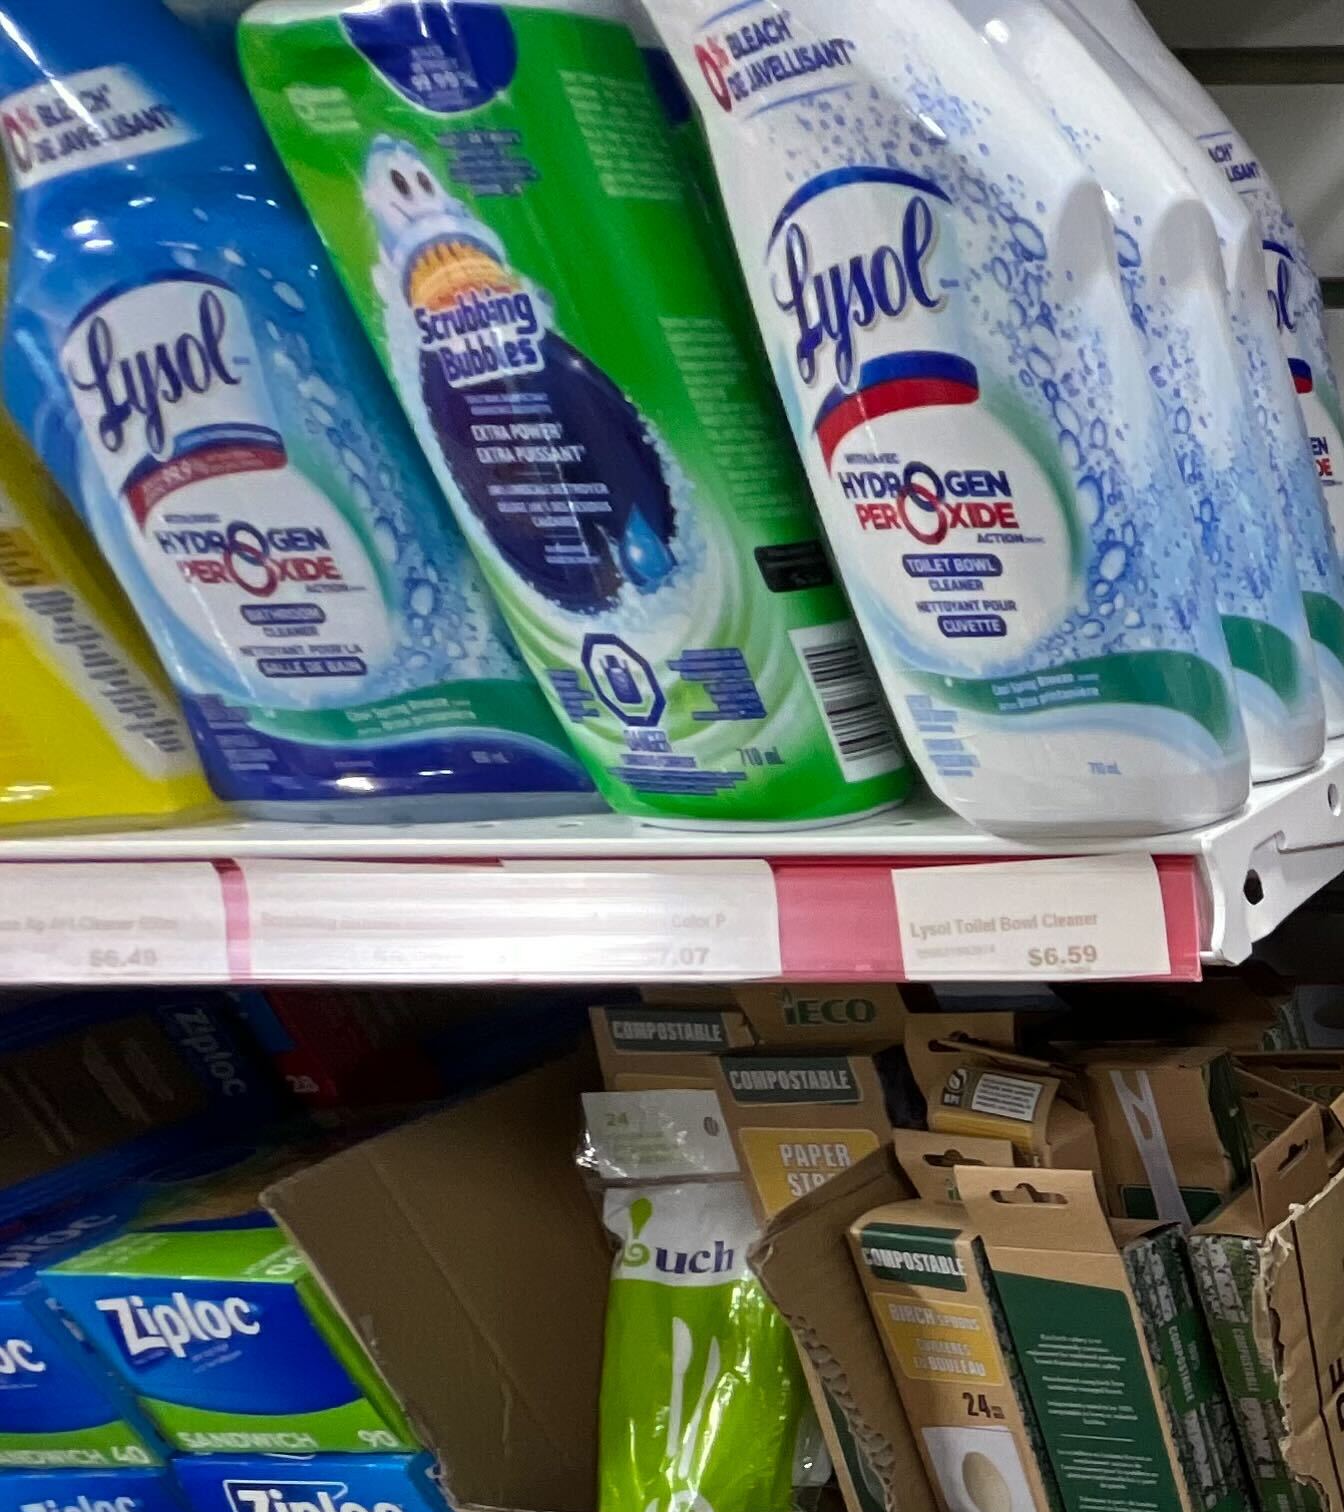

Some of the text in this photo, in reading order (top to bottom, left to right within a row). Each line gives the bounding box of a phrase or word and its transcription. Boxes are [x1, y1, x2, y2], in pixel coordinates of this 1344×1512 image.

[775, 196, 943, 387] Lysol
[414, 289, 538, 345] Scrubbing
[71, 290, 241, 452] Lysol
[440, 337, 538, 381] Bubbles
[838, 461, 1012, 512] HYDROGEN
[855, 483, 1020, 545] PEROXIDE
[155, 521, 331, 566] HYDROGEN
[177, 540, 343, 597] PEROXIDE
[907, 556, 998, 573] TOILET BOWL
[929, 579, 985, 592] CLEANER
[943, 619, 1001, 633] CUVETTE
[910, 911, 1098, 940] Lysol Toilet Bowl Cleaner
[1027, 944, 1098, 967] $6.59
[611, 1020, 724, 1042] COMPOSTABLE
[729, 1068, 853, 1092] COMPOSTABLE
[778, 1144, 852, 1169] PAPER
[862, 1246, 967, 1277] COMPOSTABLE
[96, 1292, 261, 1358] Ziploc
[961, 1391, 990, 1418] 24
[174, 1428, 399, 1451] SANDWICH 90
